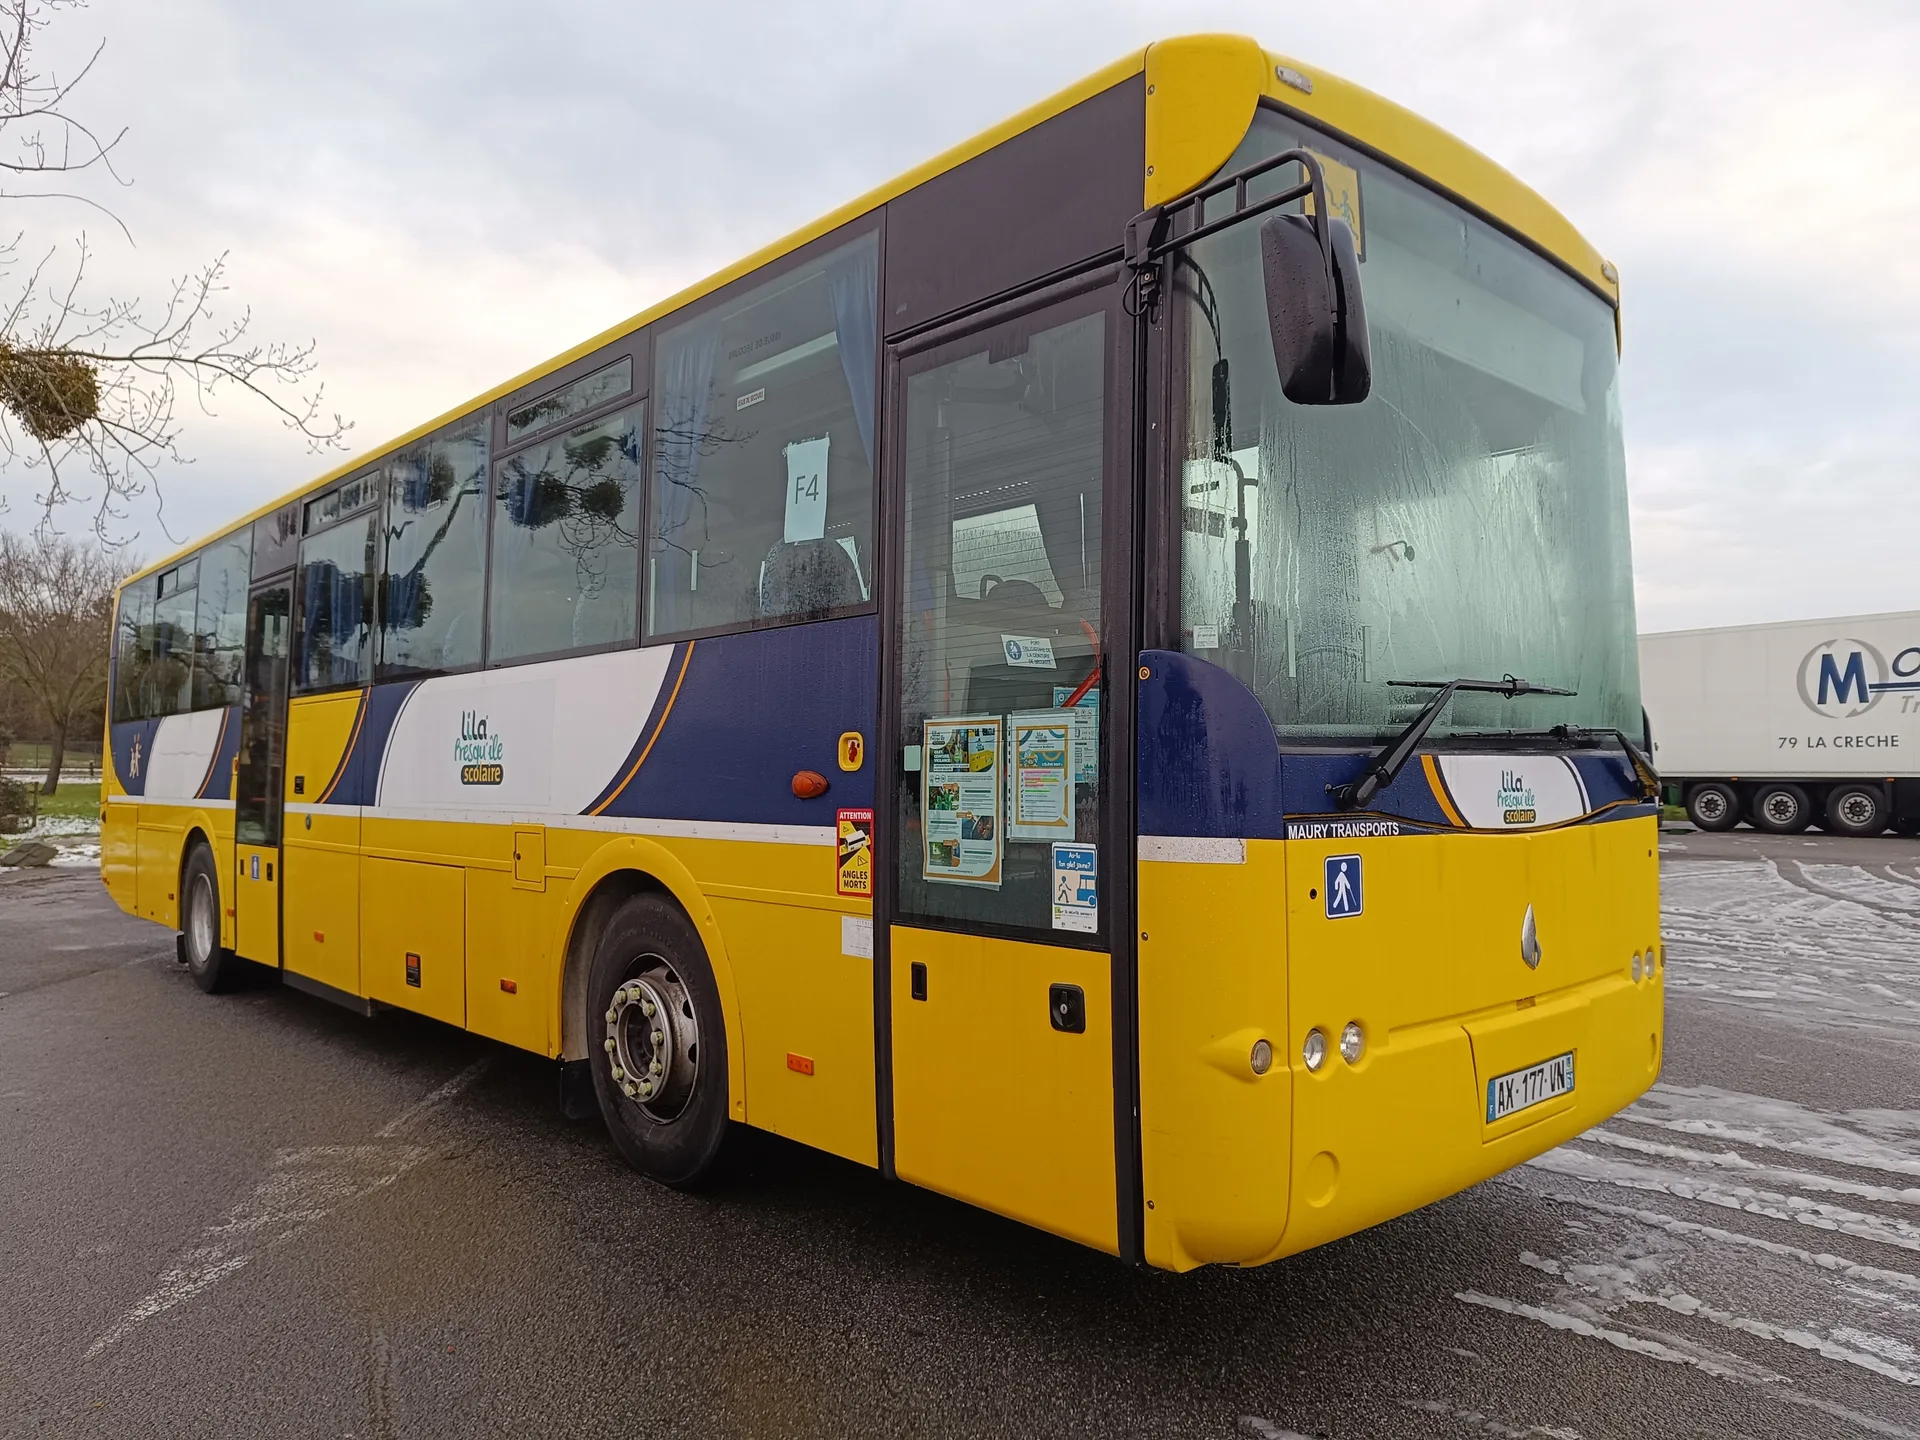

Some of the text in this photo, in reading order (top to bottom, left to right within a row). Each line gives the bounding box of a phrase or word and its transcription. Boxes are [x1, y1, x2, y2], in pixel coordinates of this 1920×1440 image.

[795, 474, 819, 504] F4
[1778, 735, 1899, 748] 79 LA CRECHE
[463, 761, 501, 782] scolaire
[839, 811, 872, 820] ATTENTION
[1505, 809, 1535, 822] scolaire
[1288, 822, 1400, 840] MAURY TRANSPORTS
[842, 870, 868, 880] ANGLES
[843, 879, 867, 890] MORTS
